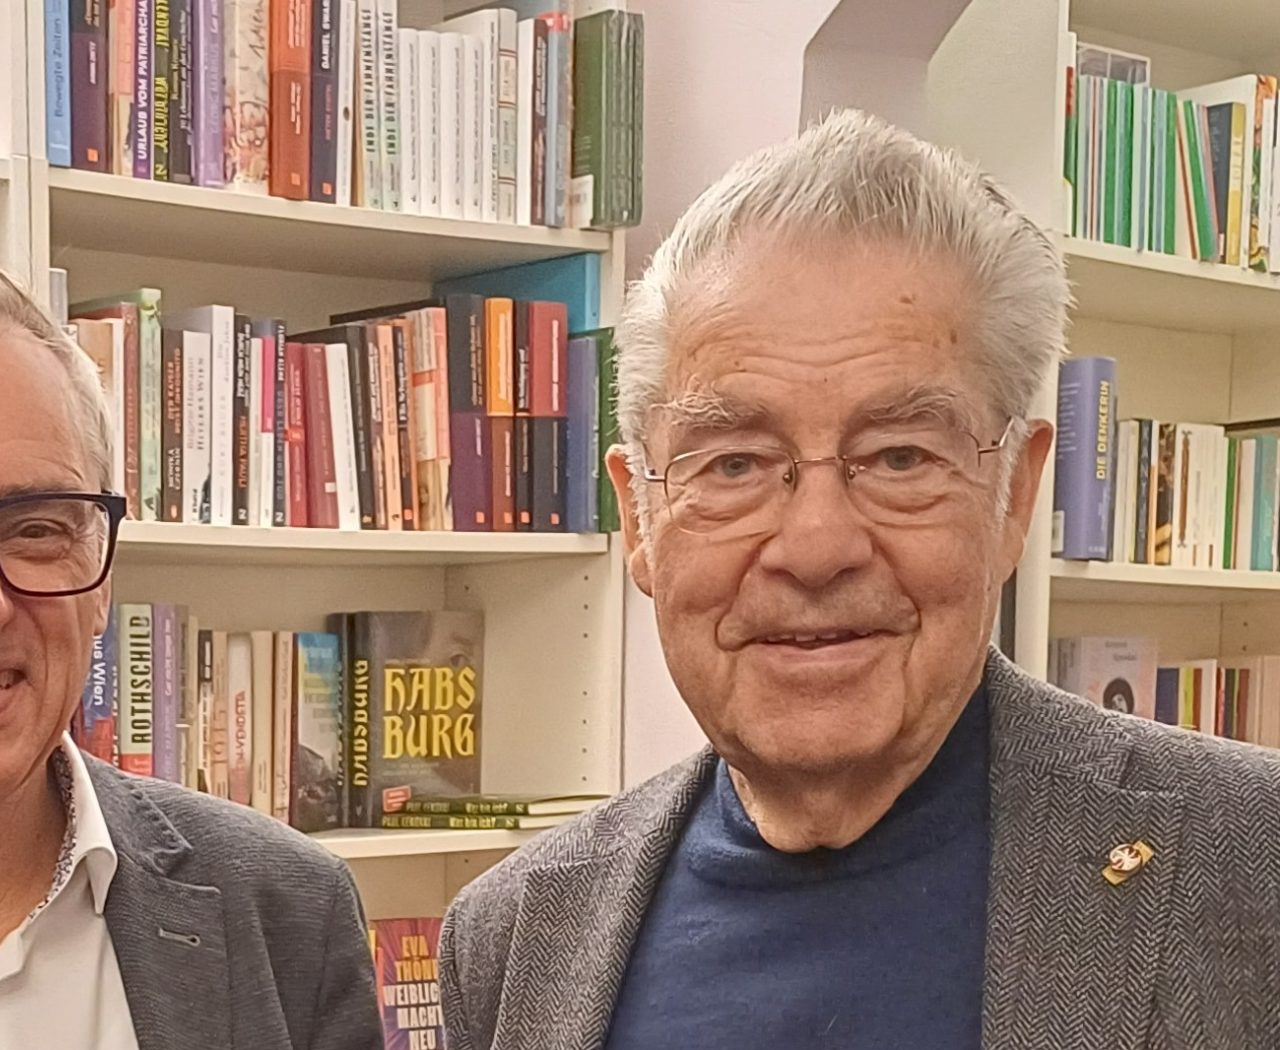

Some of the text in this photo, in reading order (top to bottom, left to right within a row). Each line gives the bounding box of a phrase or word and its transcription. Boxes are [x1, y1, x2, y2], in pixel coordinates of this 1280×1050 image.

[137, 0, 149, 159] URLAUB VOM PATRIARCHA
[1096, 381, 1110, 481] DIE DENKERIN
[92, 662, 106, 706] Wien
[129, 615, 152, 745] ROTHSCHILD
[383, 666, 476, 712] HABS
[382, 713, 475, 760] BURG
[401, 935, 429, 958] EVA
[395, 958, 439, 982] THÖN
[382, 983, 441, 1006] WEIBLIC
[409, 1029, 436, 1050] NEU
